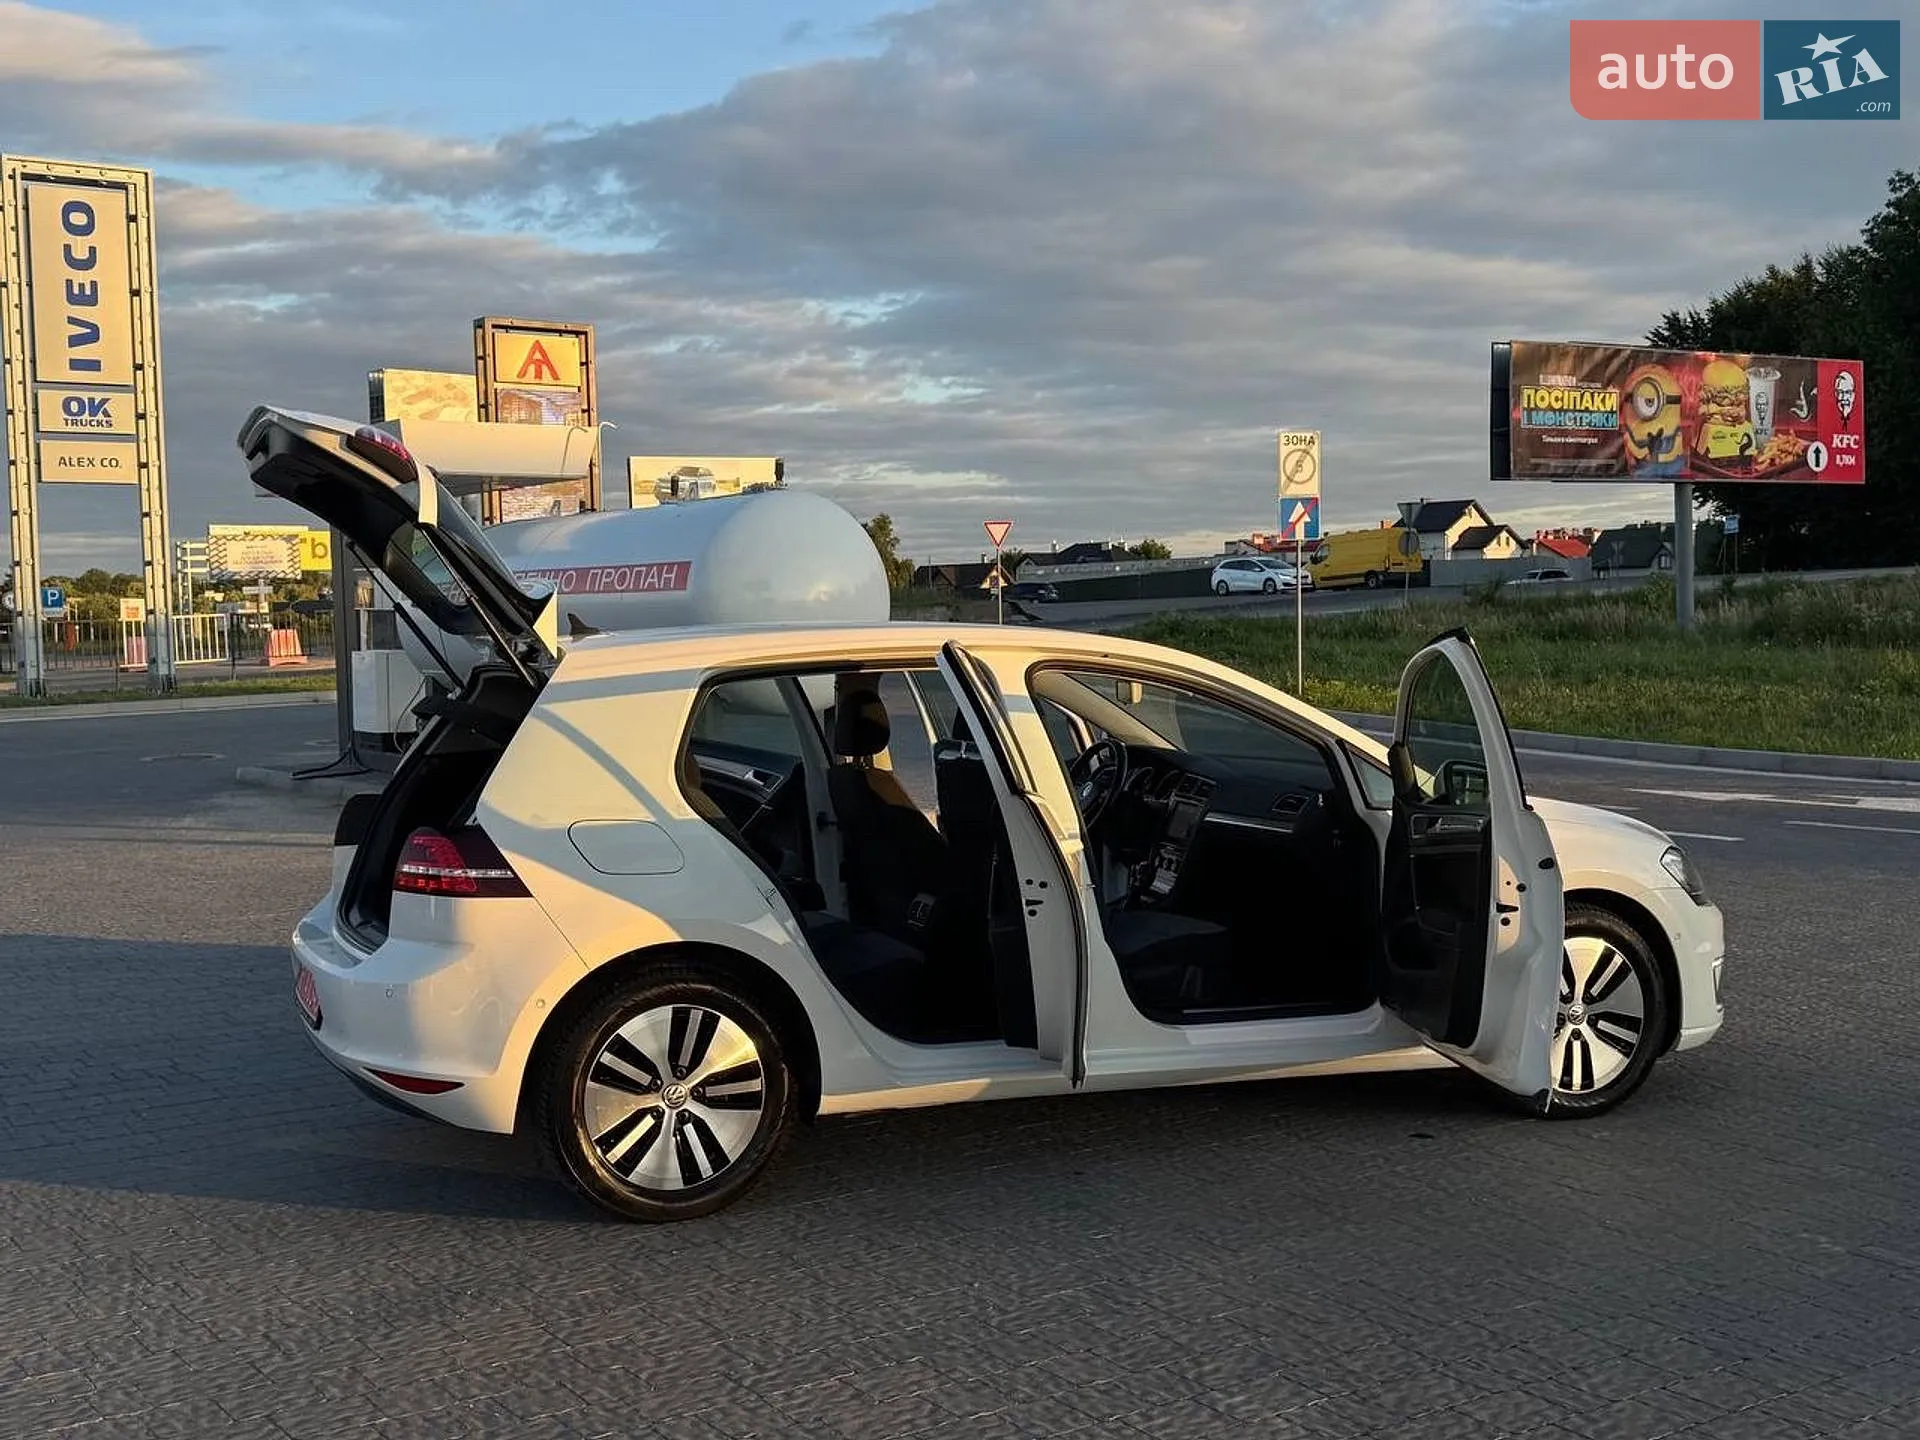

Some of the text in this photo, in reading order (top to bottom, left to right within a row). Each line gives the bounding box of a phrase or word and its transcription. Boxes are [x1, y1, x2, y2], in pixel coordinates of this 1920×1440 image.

[61, 200, 102, 372] IVECO
[62, 396, 113, 417] OK
[1522, 388, 1617, 412] ПОСІПАКИ
[63, 418, 114, 428] TRUCKS
[1283, 435, 1315, 446] ЗОНА
[1832, 434, 1860, 449] KFC
[58, 456, 96, 468] ALEX
[586, 564, 678, 591] ПРОПАН
[47, 590, 59, 605] P
